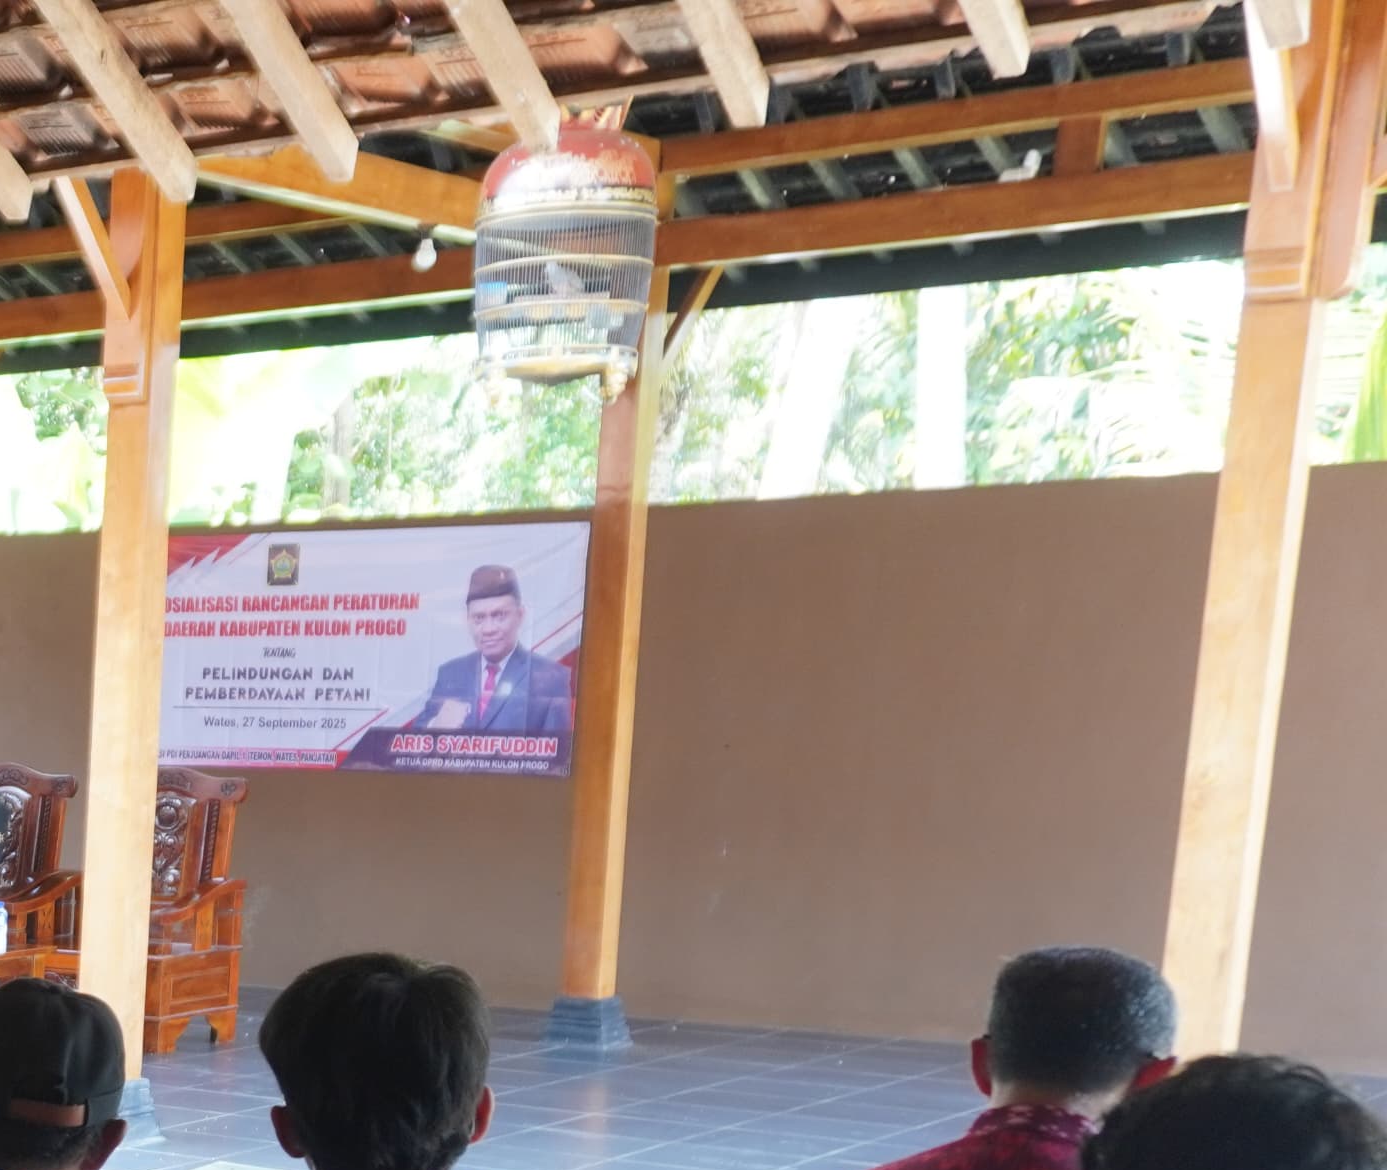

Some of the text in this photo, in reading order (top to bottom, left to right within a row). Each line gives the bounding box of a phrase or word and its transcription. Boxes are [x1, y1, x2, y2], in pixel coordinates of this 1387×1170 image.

[165, 593, 420, 613] OSIALISASI RANCANGAN PERATURAN
[164, 619, 406, 637] DAERAH KABUPATEN KULON PROGO
[202, 667, 354, 680] PELINDUNGAN DAN
[185, 687, 371, 701] PEMBERDAYAAN PETANI
[242, 717, 255, 728] 27
[258, 716, 317, 730] September
[320, 718, 347, 729] 2025
[391, 734, 559, 756] ARIS SYARIFUDDIN
[395, 757, 421, 767] KETUA
[444, 758, 490, 769] KABUPATEN
[491, 760, 519, 769] KULON
[520, 760, 549, 770] PROGO
